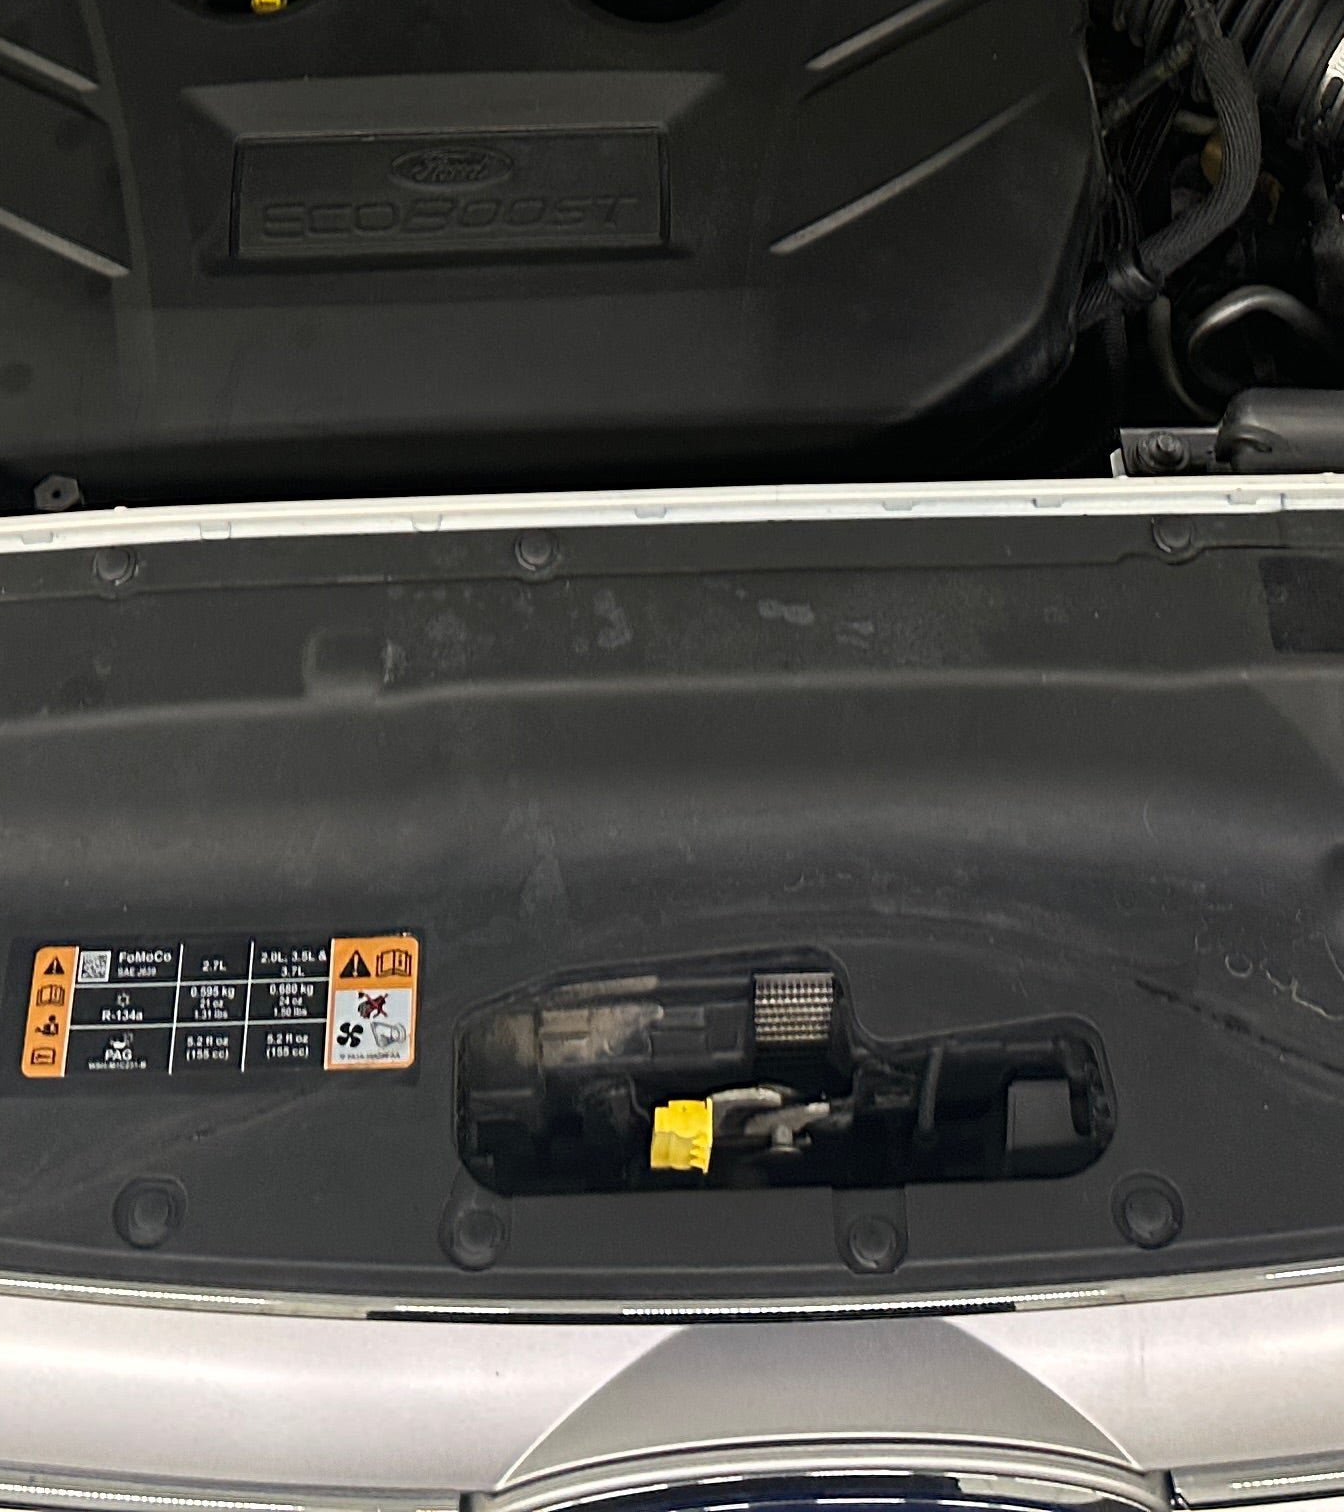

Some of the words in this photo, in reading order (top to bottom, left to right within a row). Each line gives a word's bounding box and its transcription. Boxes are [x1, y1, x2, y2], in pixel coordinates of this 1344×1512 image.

[261, 195, 639, 239] ECOBOOST
[118, 949, 172, 964] FoMoCo
[202, 959, 227, 972] 2.7L
[281, 965, 305, 978] 3.7L
[221, 985, 235, 1000] kg
[299, 983, 314, 998] kg
[101, 1009, 143, 1022] R-134a
[105, 1049, 133, 1062] PAG
